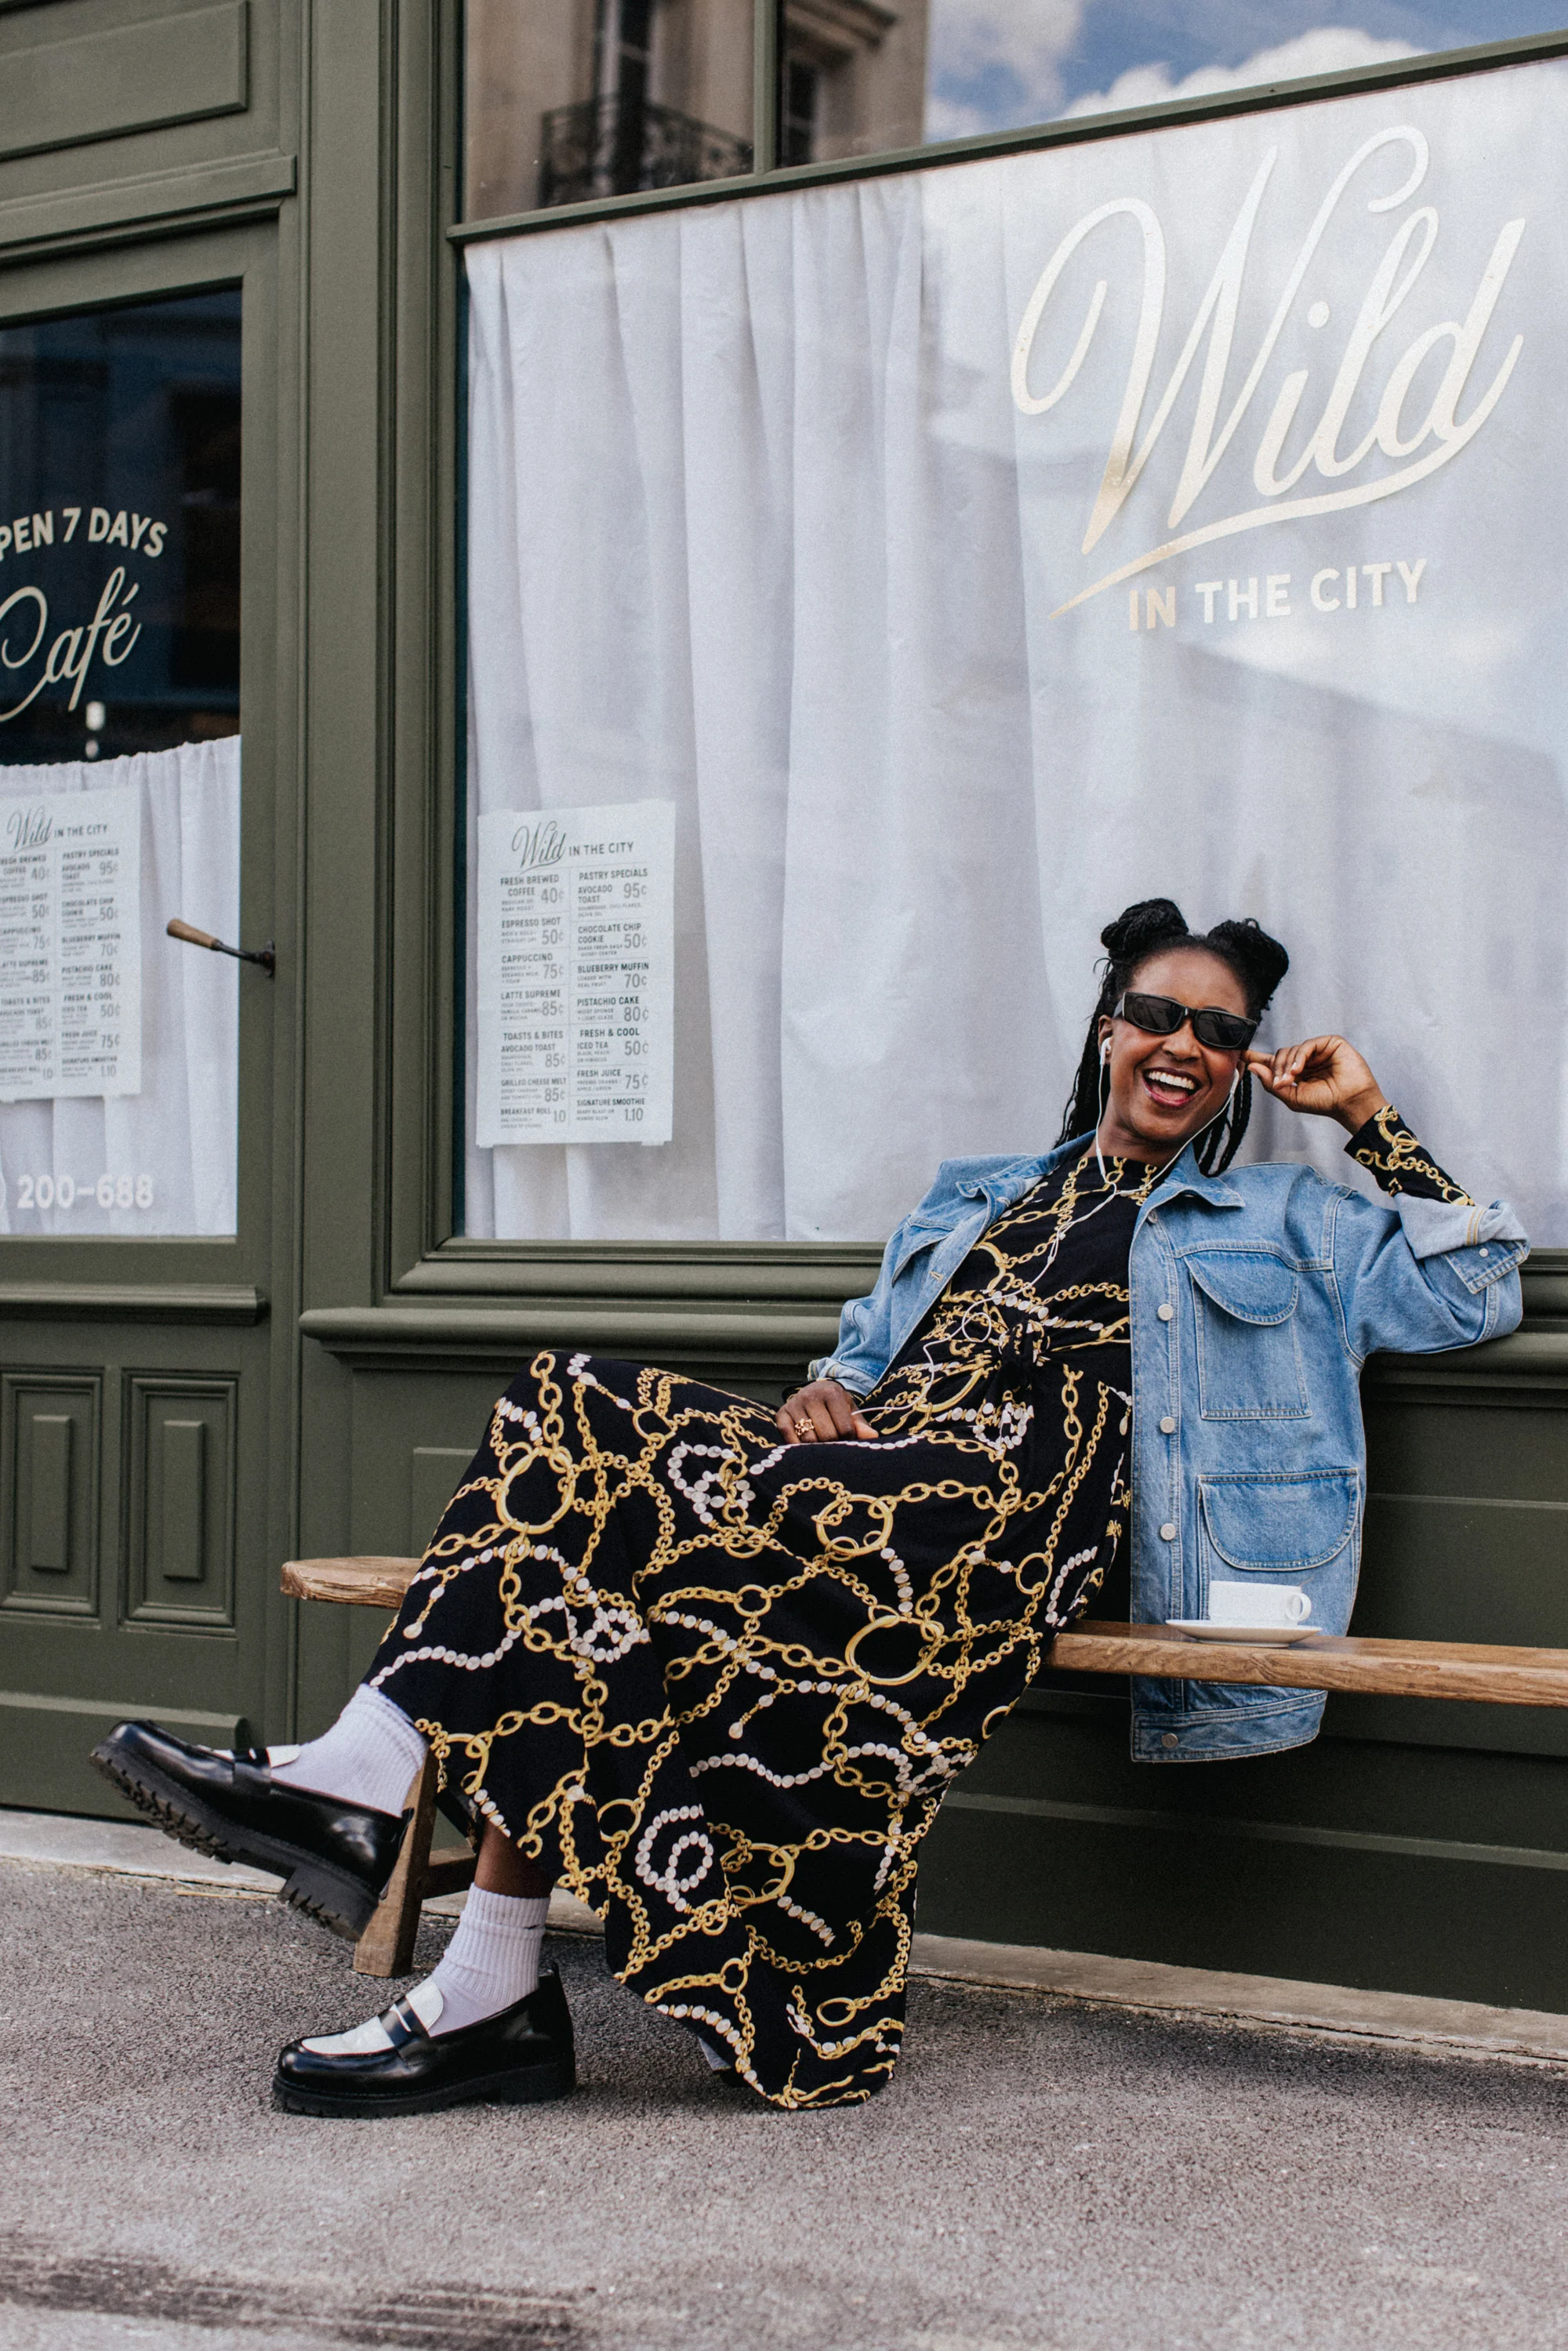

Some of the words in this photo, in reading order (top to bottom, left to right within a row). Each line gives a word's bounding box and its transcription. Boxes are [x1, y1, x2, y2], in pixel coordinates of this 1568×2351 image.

[1011, 125, 1526, 621] Wild
[0, 510, 53, 562] PEN
[63, 507, 82, 542] 7
[88, 507, 169, 557] DAYS
[1129, 586, 1176, 631] IN
[1195, 574, 1292, 624] THE
[1310, 559, 1427, 612] CITY
[0, 566, 141, 722] Café
[7, 805, 53, 854] Wild
[54, 829, 64, 838] IN
[67, 826, 84, 836] THE
[86, 825, 107, 836] CITY
[511, 821, 566, 875] Wild
[569, 845, 579, 856] IN
[585, 844, 604, 854] THE
[608, 841, 633, 853] CITY
[500, 876, 524, 886] FRESH
[527, 874, 559, 884] BREWED
[579, 870, 608, 881] PASTRY
[611, 868, 648, 878] SPECIALS
[508, 887, 535, 897] COFFEE
[578, 884, 612, 894] AVOCADO
[502, 918, 539, 928] ESPRESSO
[542, 916, 561, 926] SHOT
[578, 923, 620, 934] CHOCOLATE
[623, 923, 641, 931] CHIP
[578, 934, 604, 944] COOKIE
[502, 952, 553, 963] CAPPUCCINO
[578, 963, 619, 974] BLUEBERRY
[501, 991, 522, 1000] LATTE
[525, 989, 561, 999] SUPREME
[577, 997, 616, 1007] PISTACHIO
[619, 996, 639, 1005] CAKE
[503, 1032, 532, 1041] TOASTS
[535, 1031, 539, 1039] &
[542, 1030, 564, 1039] BITES
[580, 1029, 605, 1038] FRESH
[608, 1028, 614, 1037] &
[617, 1027, 640, 1036] COOL
[501, 1044, 533, 1053] AVOCADO
[625, 1107, 644, 1122] 1.10
